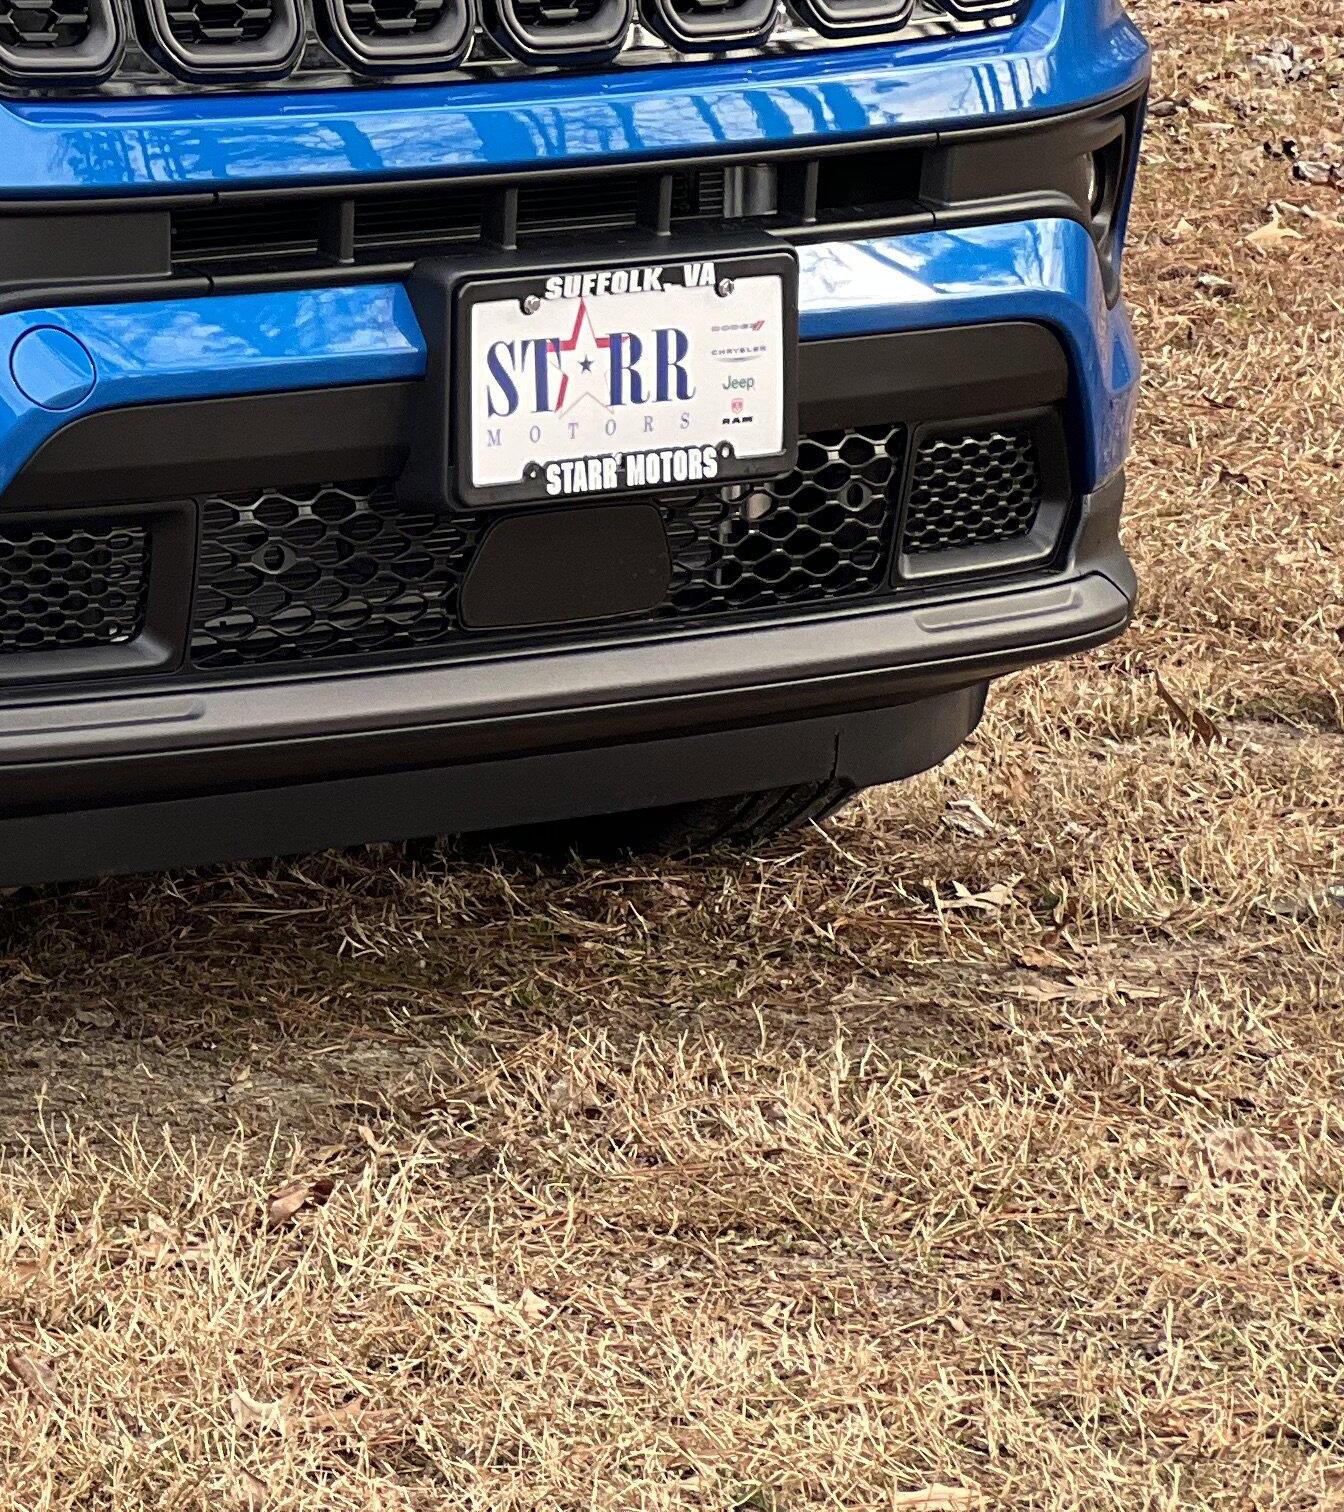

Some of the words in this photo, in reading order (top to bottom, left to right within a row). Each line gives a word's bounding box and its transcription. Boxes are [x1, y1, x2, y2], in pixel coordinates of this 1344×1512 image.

[683, 262, 716, 287] VA
[711, 345, 767, 356] CHRYSLER
[722, 375, 756, 391] Jeep
[487, 413, 690, 447] MOTORS
[722, 415, 753, 425] RAM
[546, 457, 618, 496] STARR
[626, 446, 719, 487] MOTORS
